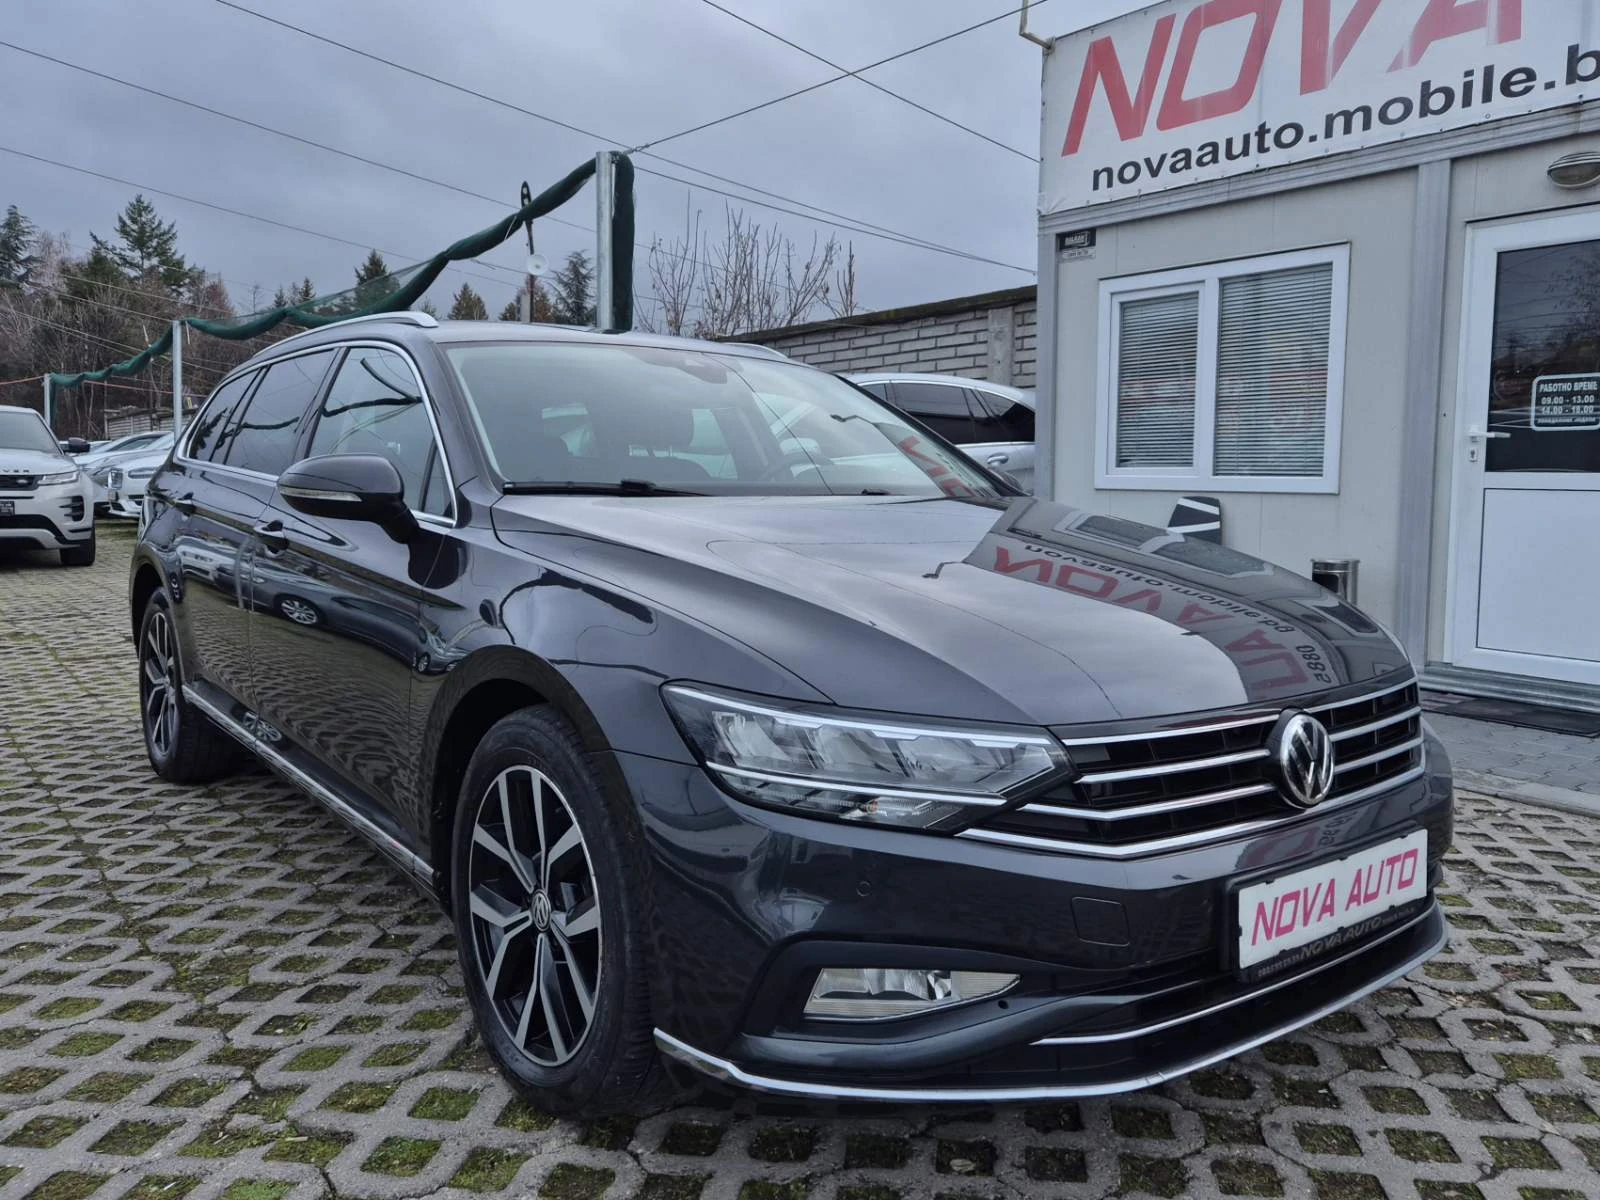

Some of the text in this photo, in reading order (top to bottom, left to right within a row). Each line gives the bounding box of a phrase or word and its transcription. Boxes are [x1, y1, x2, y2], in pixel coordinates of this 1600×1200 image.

[1092, 43, 1600, 191] novaauto.mobile.b
[1251, 848, 1418, 946] NOVA AUTO
